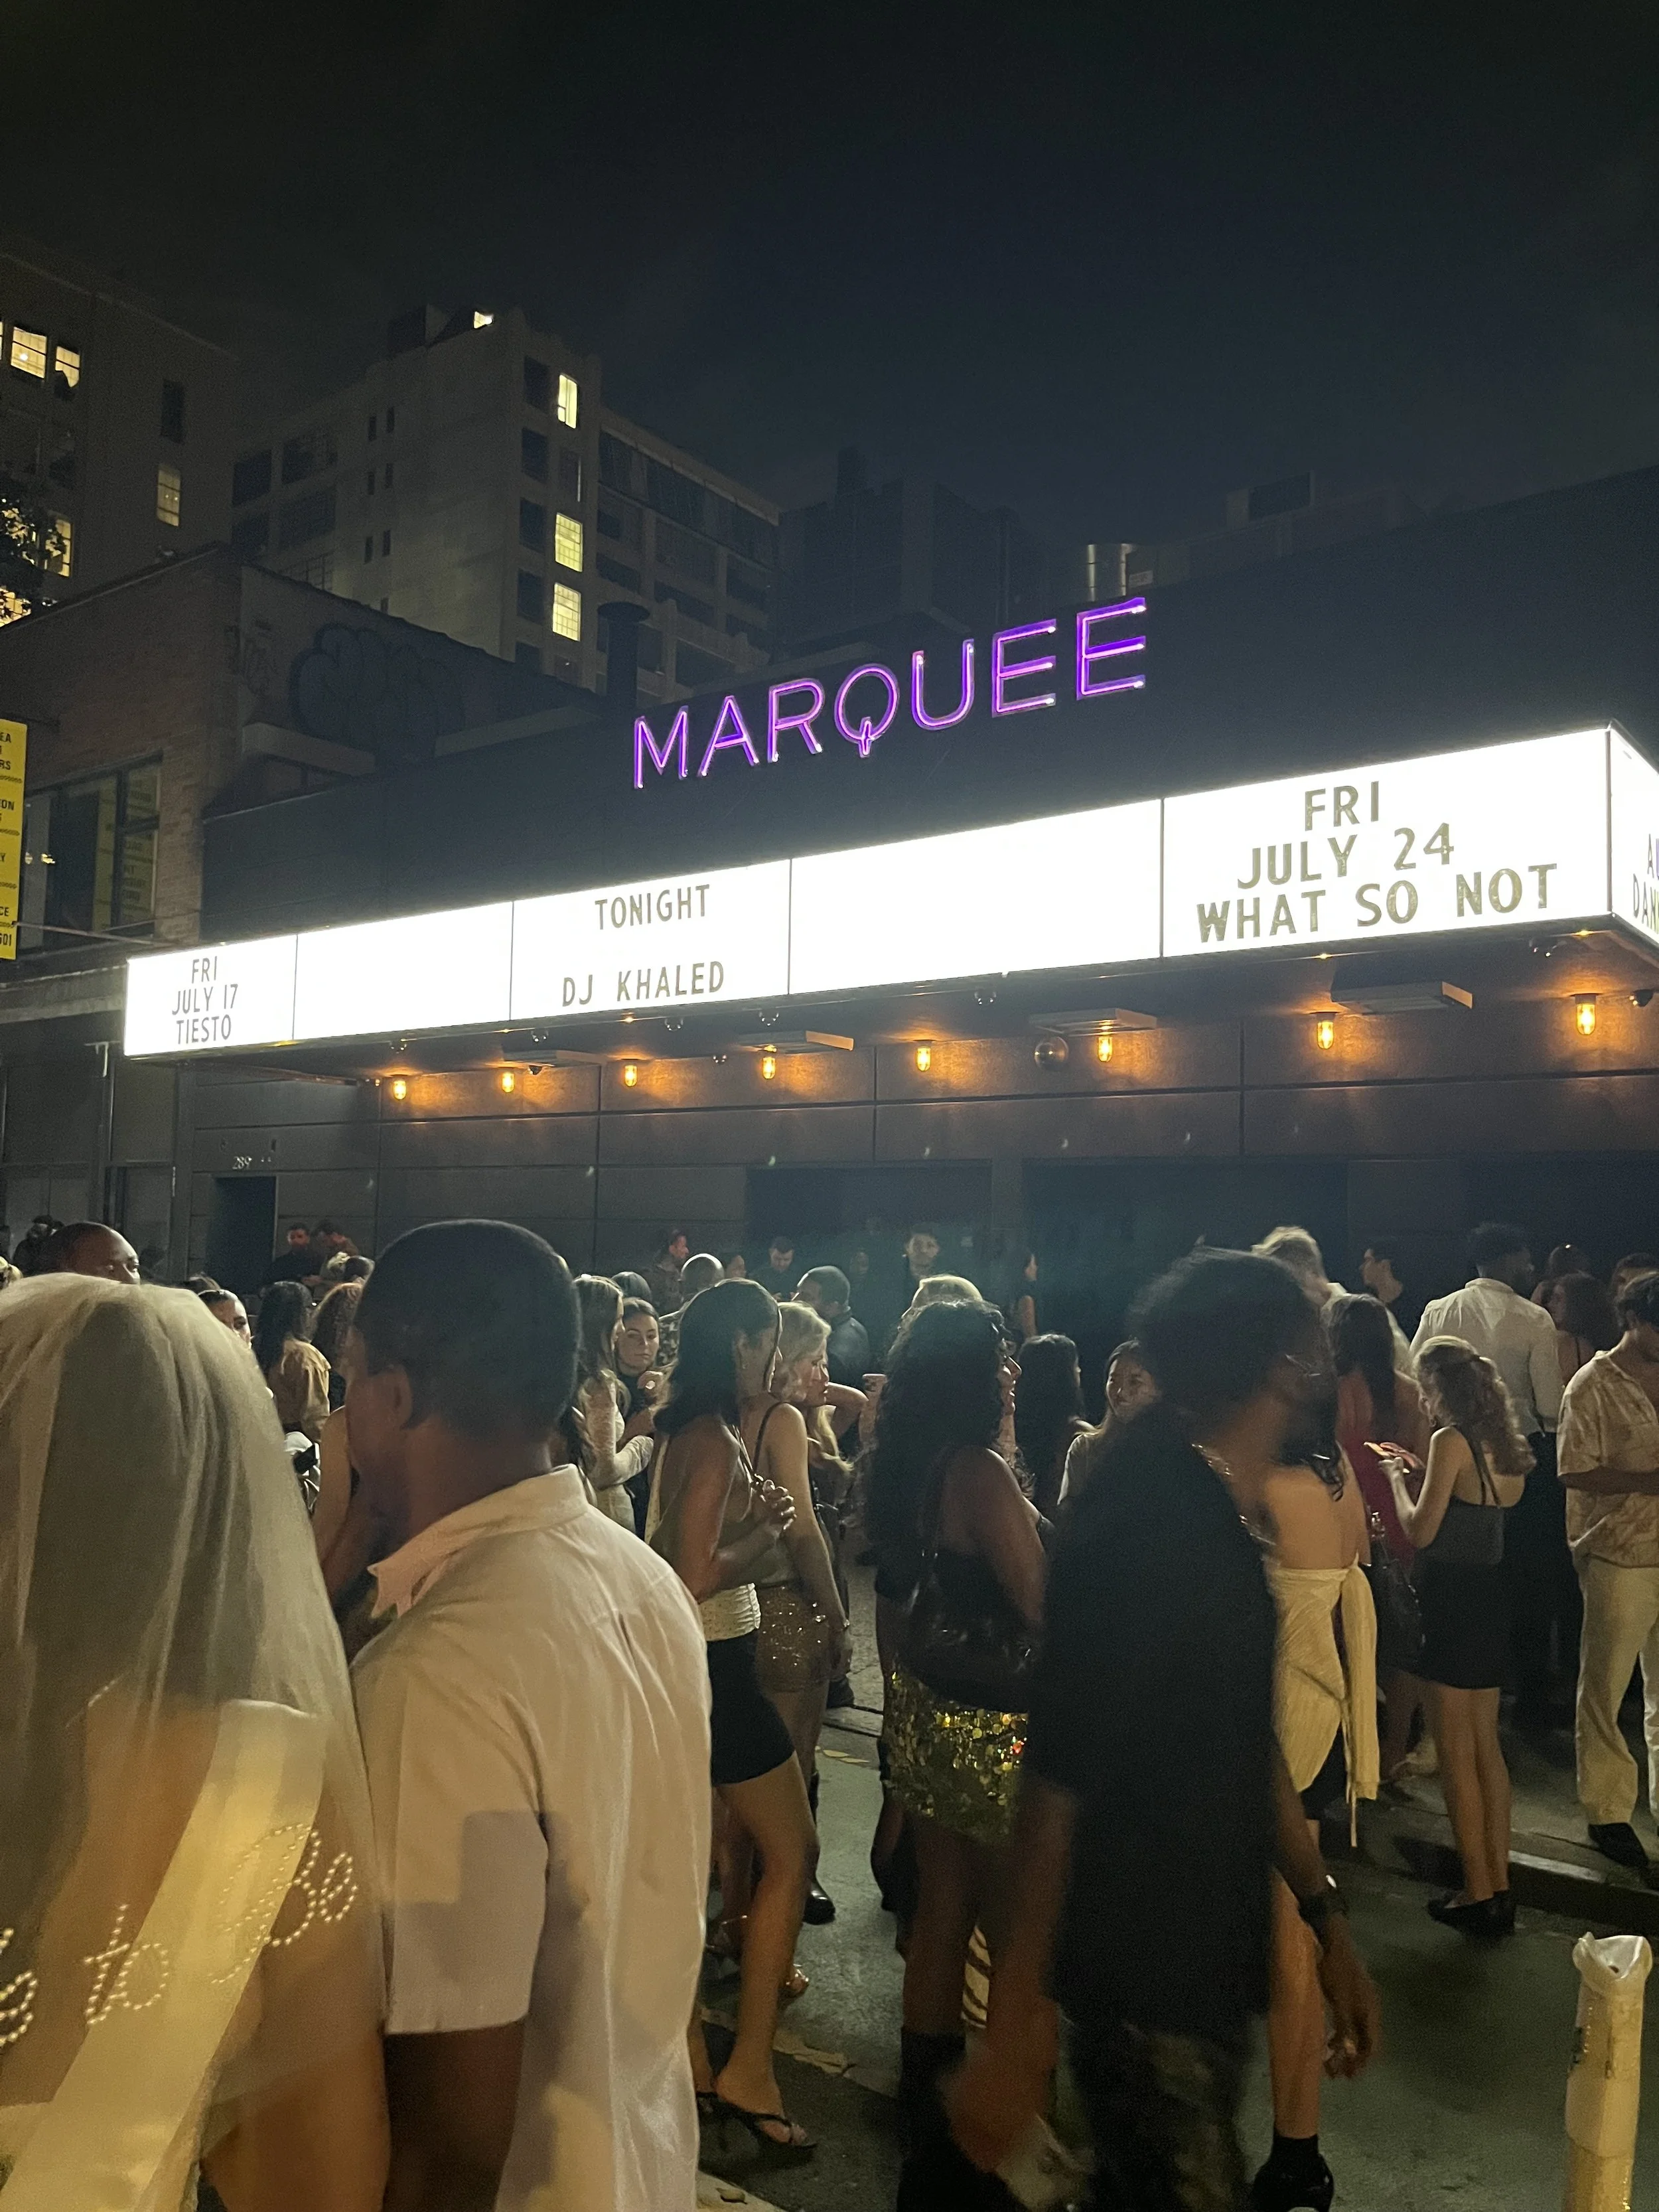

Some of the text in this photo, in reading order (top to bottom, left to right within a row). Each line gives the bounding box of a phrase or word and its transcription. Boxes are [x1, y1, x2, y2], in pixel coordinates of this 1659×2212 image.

[634, 597, 1146, 788] MARQUEE
[1304, 780, 1380, 832] FRI
[1237, 822, 1455, 889] JULY 24
[595, 884, 710, 930] TONIGHT
[1196, 863, 1557, 944] WHAT SO NOT
[191, 956, 218, 984] FRI
[562, 961, 724, 1007] DJ KHALED
[172, 984, 238, 1015] JULY 17
[177, 1014, 232, 1045] TIESTO
